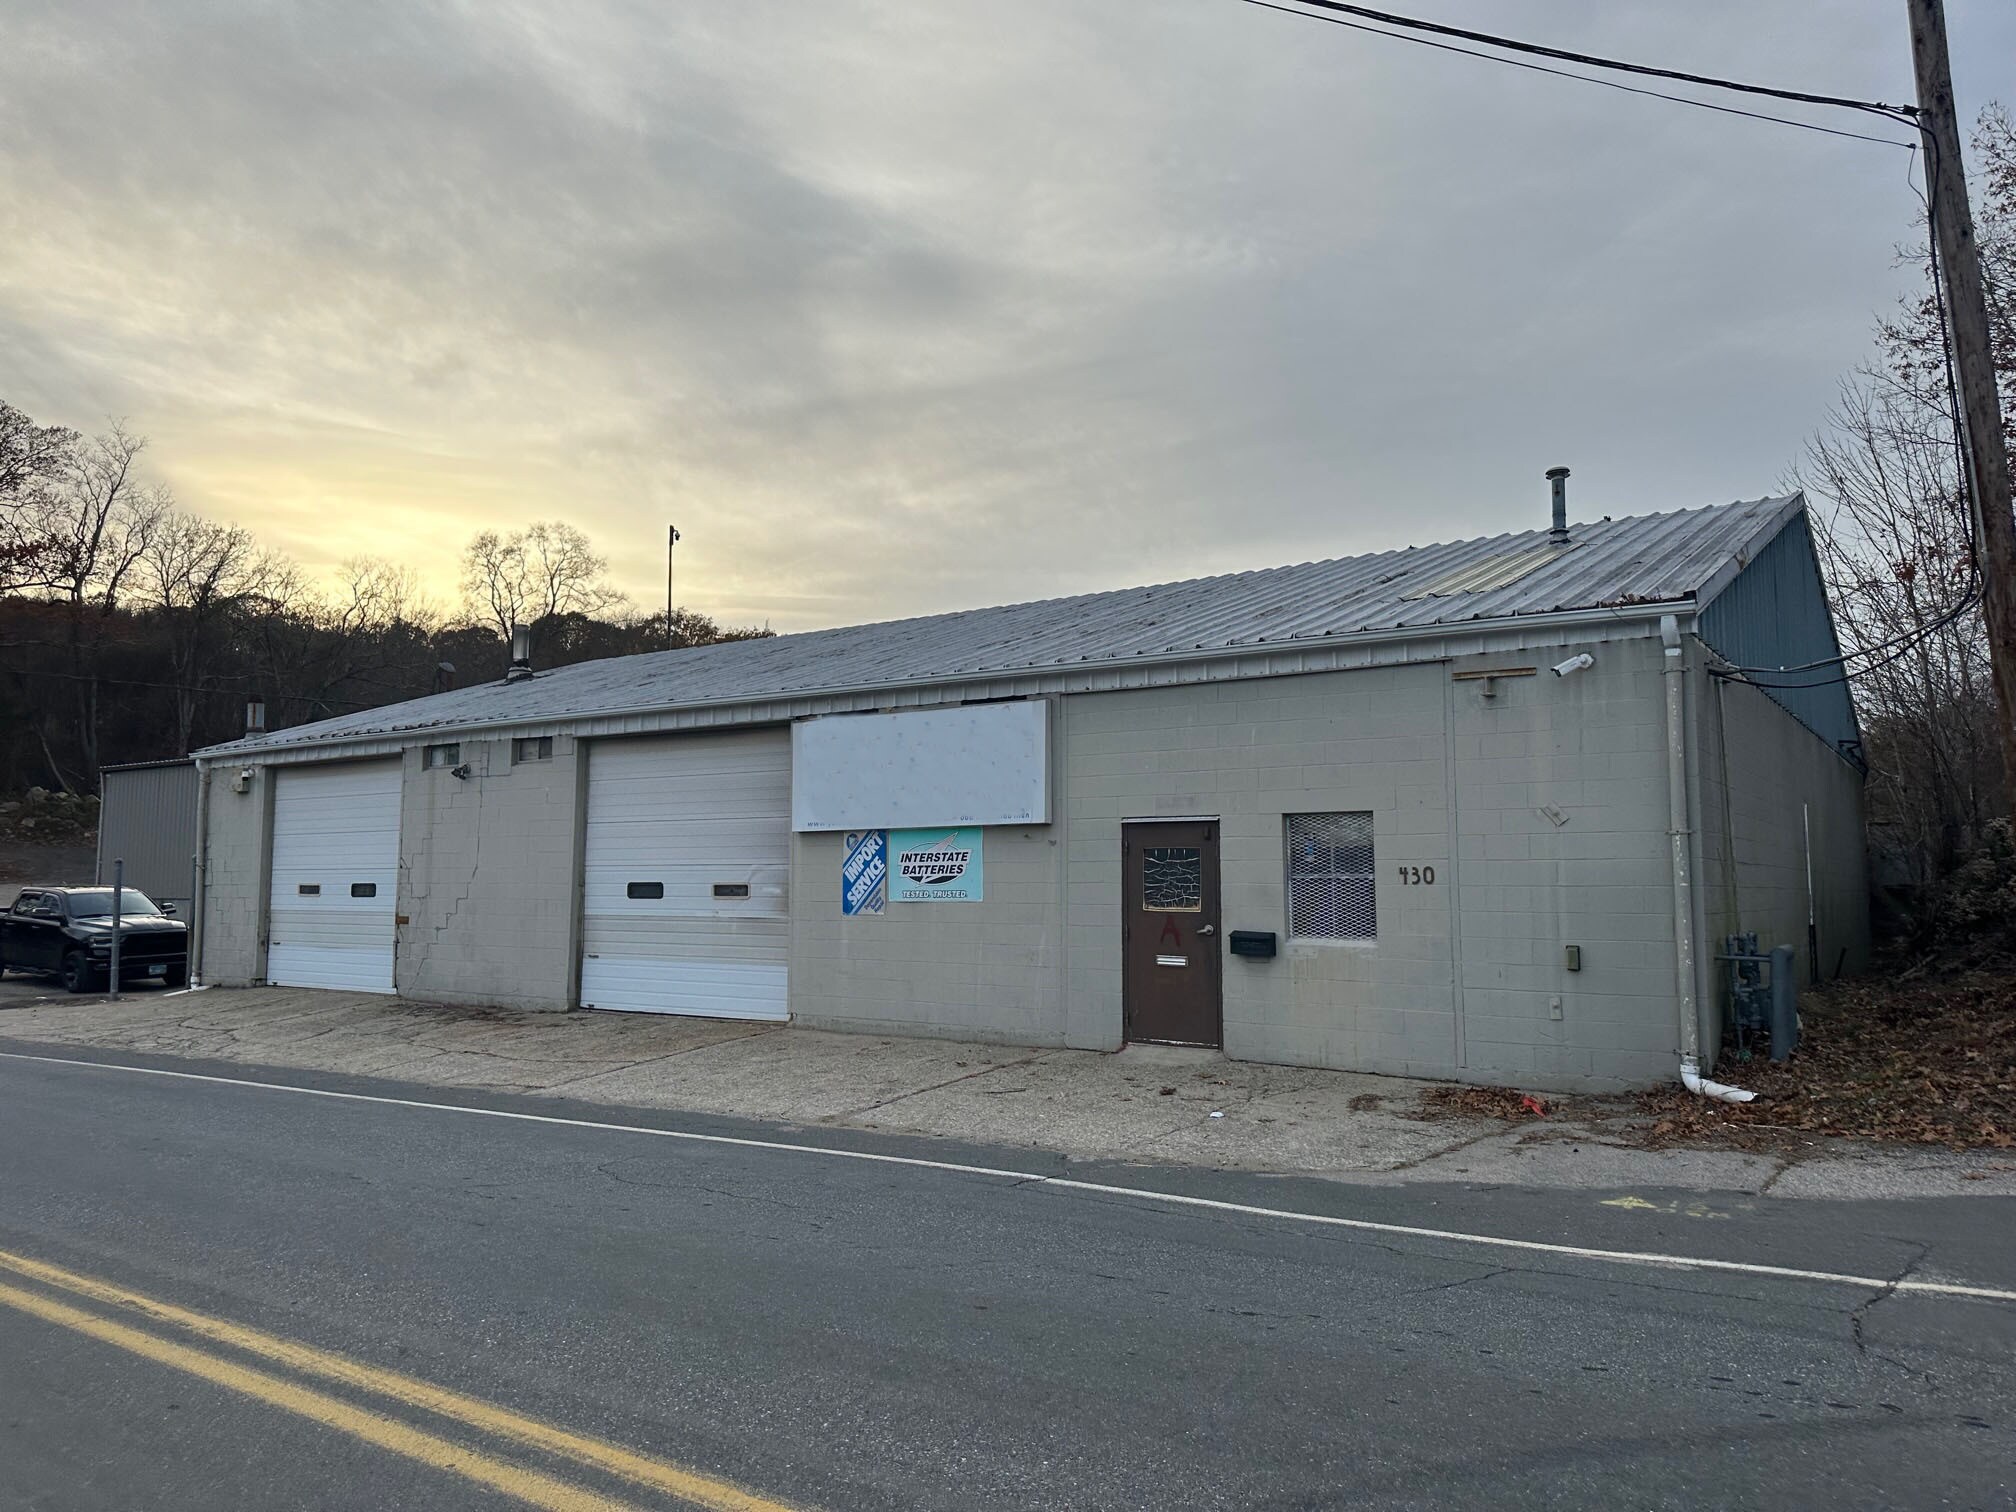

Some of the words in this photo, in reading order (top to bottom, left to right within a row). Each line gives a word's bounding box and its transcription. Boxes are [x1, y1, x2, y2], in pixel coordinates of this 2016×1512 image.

[844, 830, 883, 883] IMPORT
[900, 851, 969, 863] INTERSTATE
[902, 864, 964, 875] BATTERIES
[1399, 866, 1435, 885] 430
[846, 855, 885, 906] SERVICE
